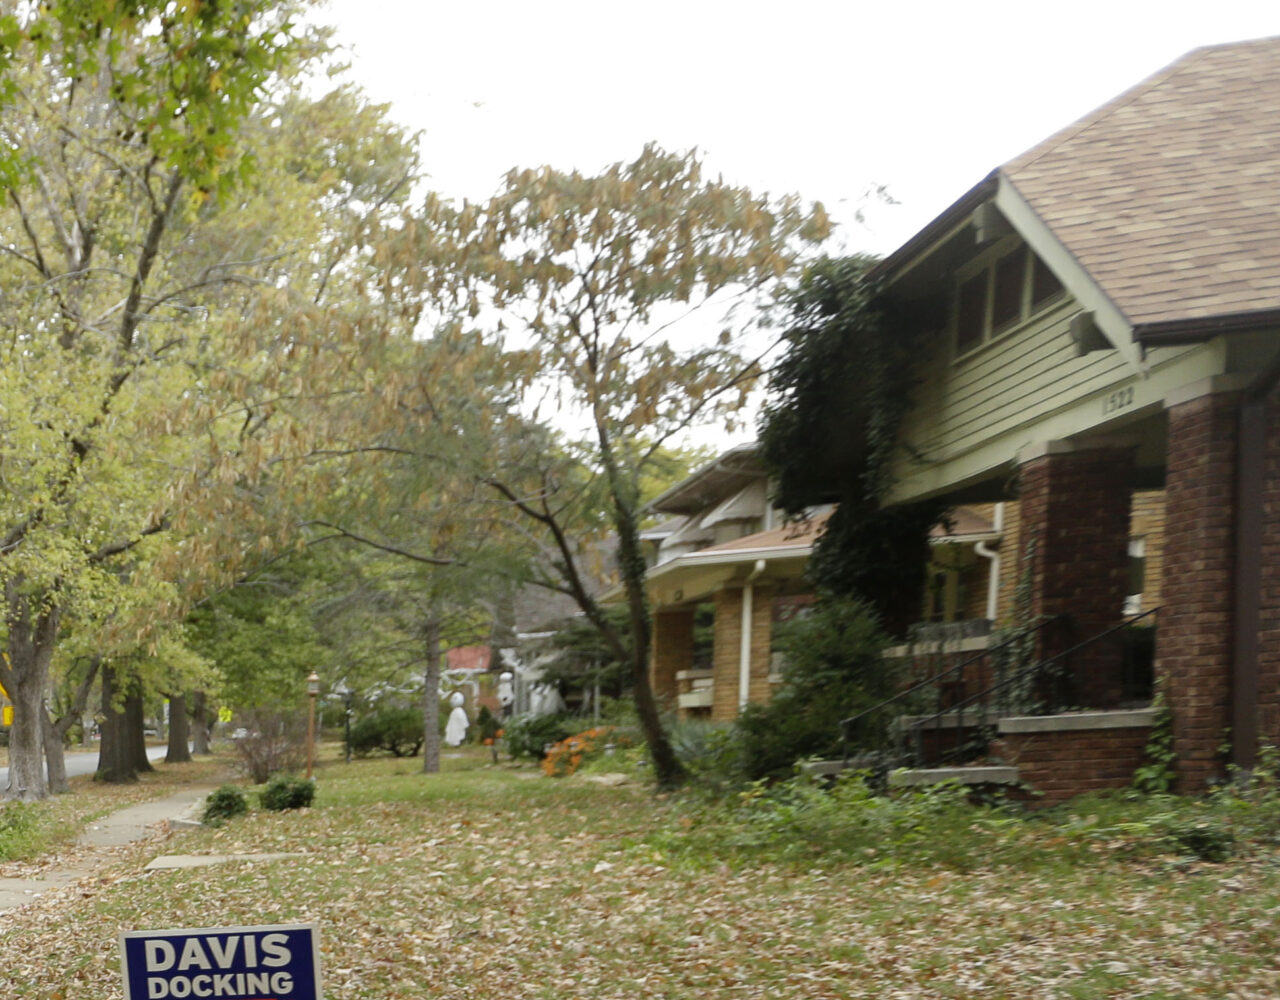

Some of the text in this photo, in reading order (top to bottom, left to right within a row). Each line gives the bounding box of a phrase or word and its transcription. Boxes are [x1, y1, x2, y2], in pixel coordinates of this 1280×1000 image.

[1103, 386, 1134, 415] 1522
[144, 933, 292, 972] DAVIS
[147, 971, 294, 999] DOCKING
